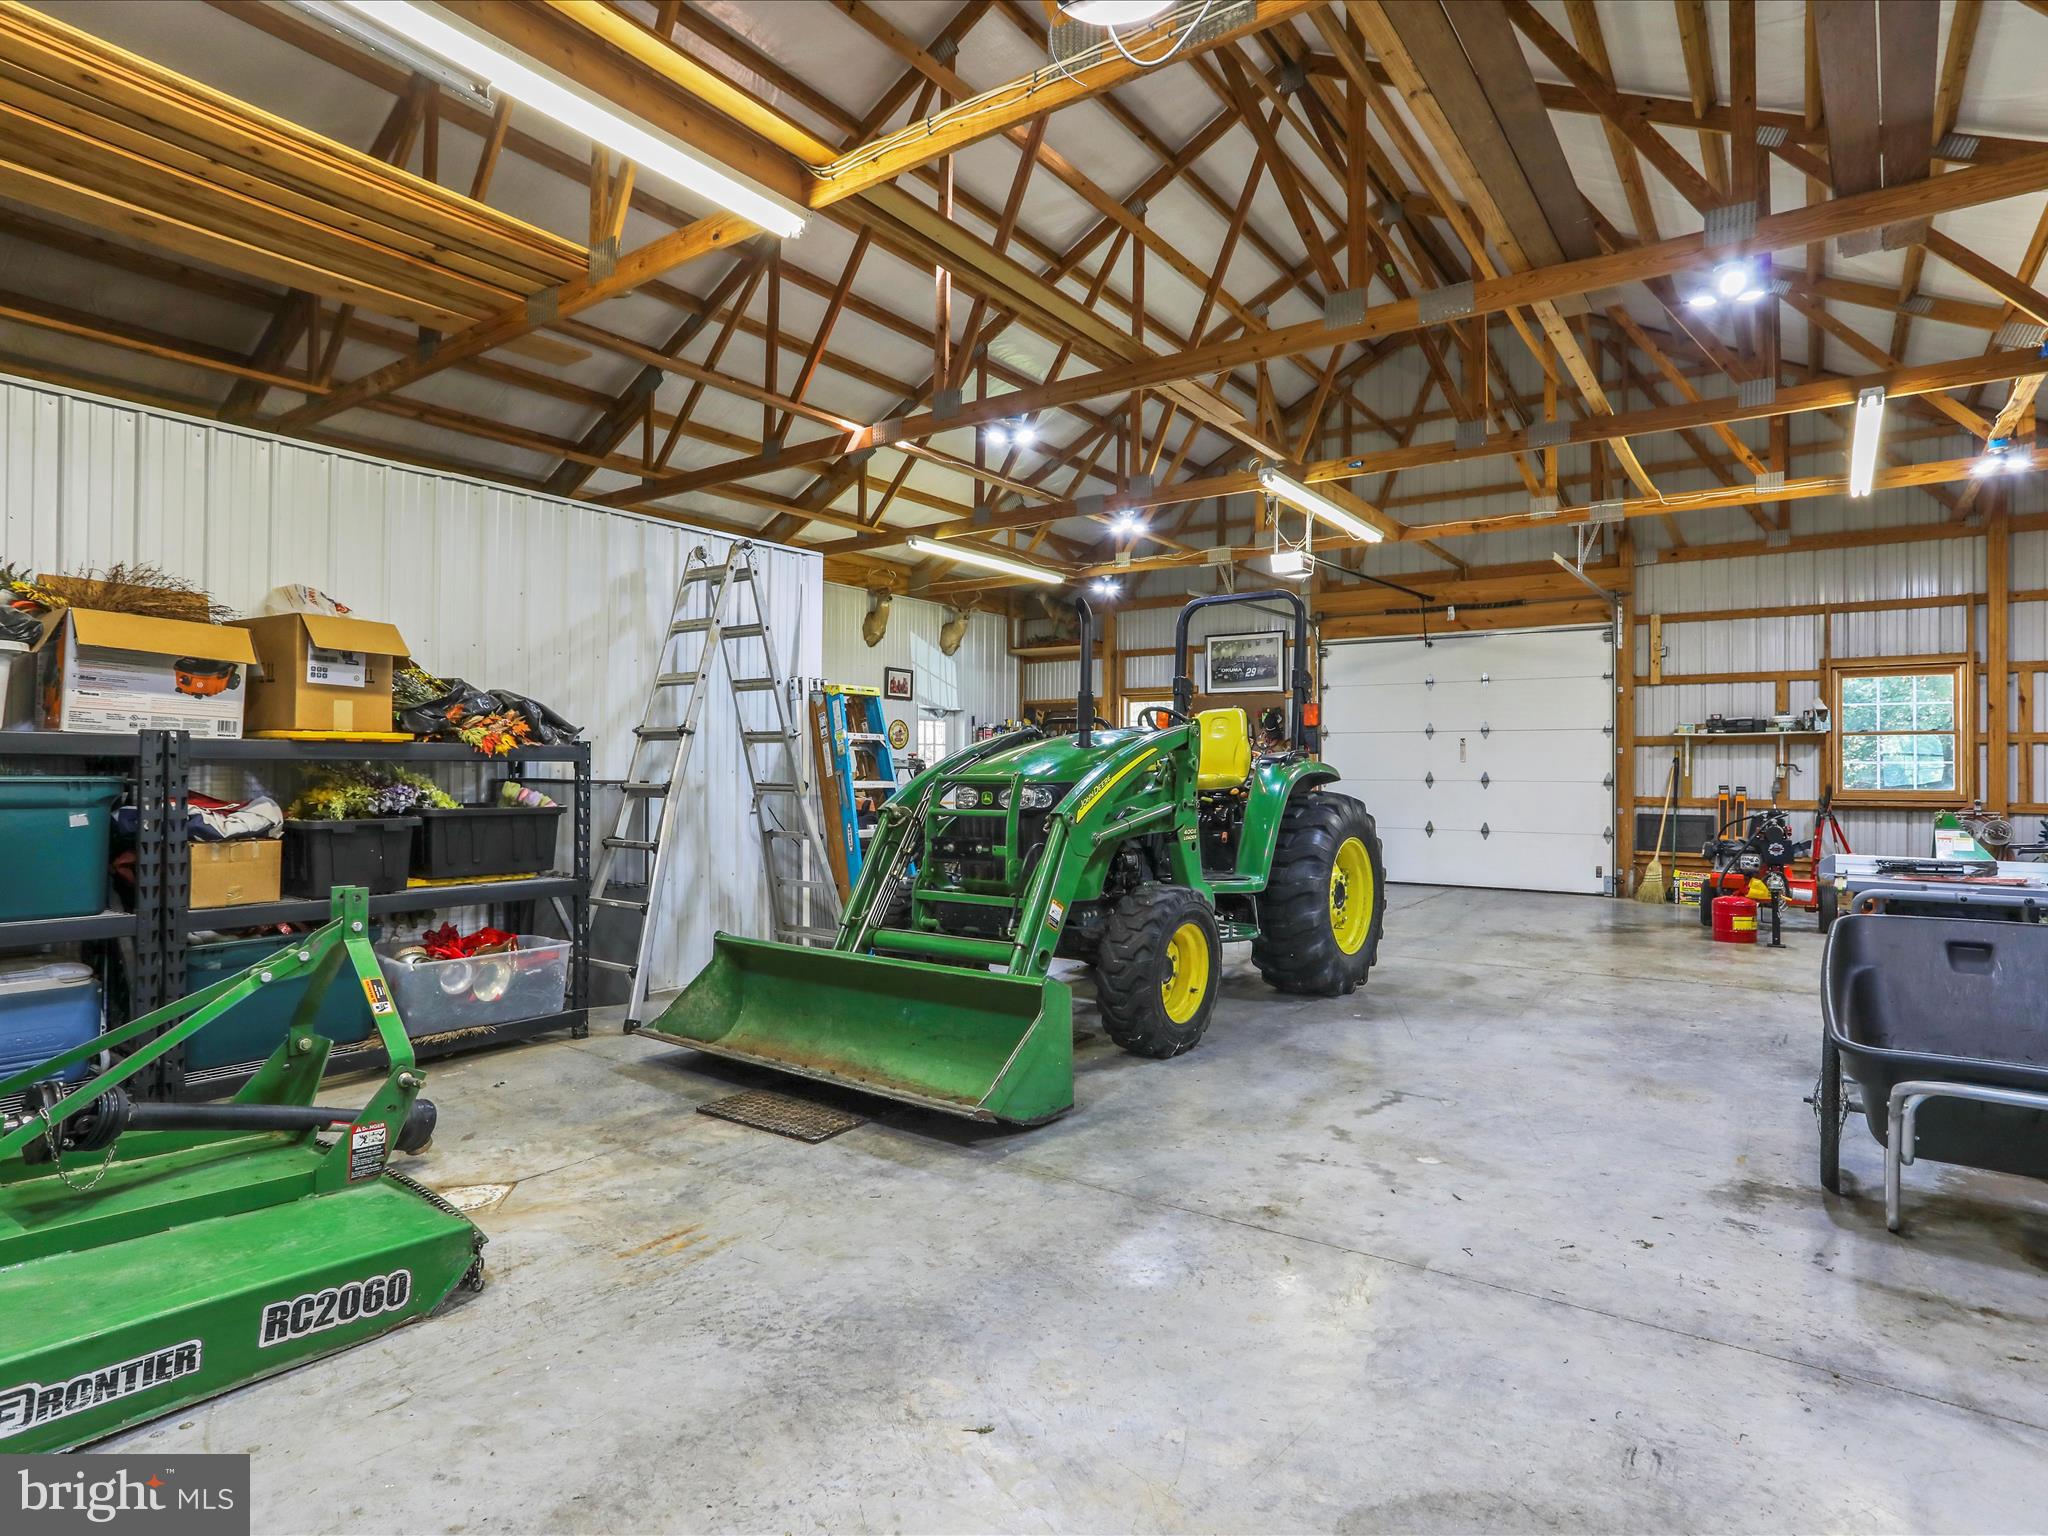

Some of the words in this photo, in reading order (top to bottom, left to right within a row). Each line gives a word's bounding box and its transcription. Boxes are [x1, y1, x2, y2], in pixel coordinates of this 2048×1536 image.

[1245, 667, 1257, 678] 29
[1080, 791, 1095, 809] JOHN
[1093, 773, 1112, 796] DEERE
[263, 1273, 410, 1343] RC2060
